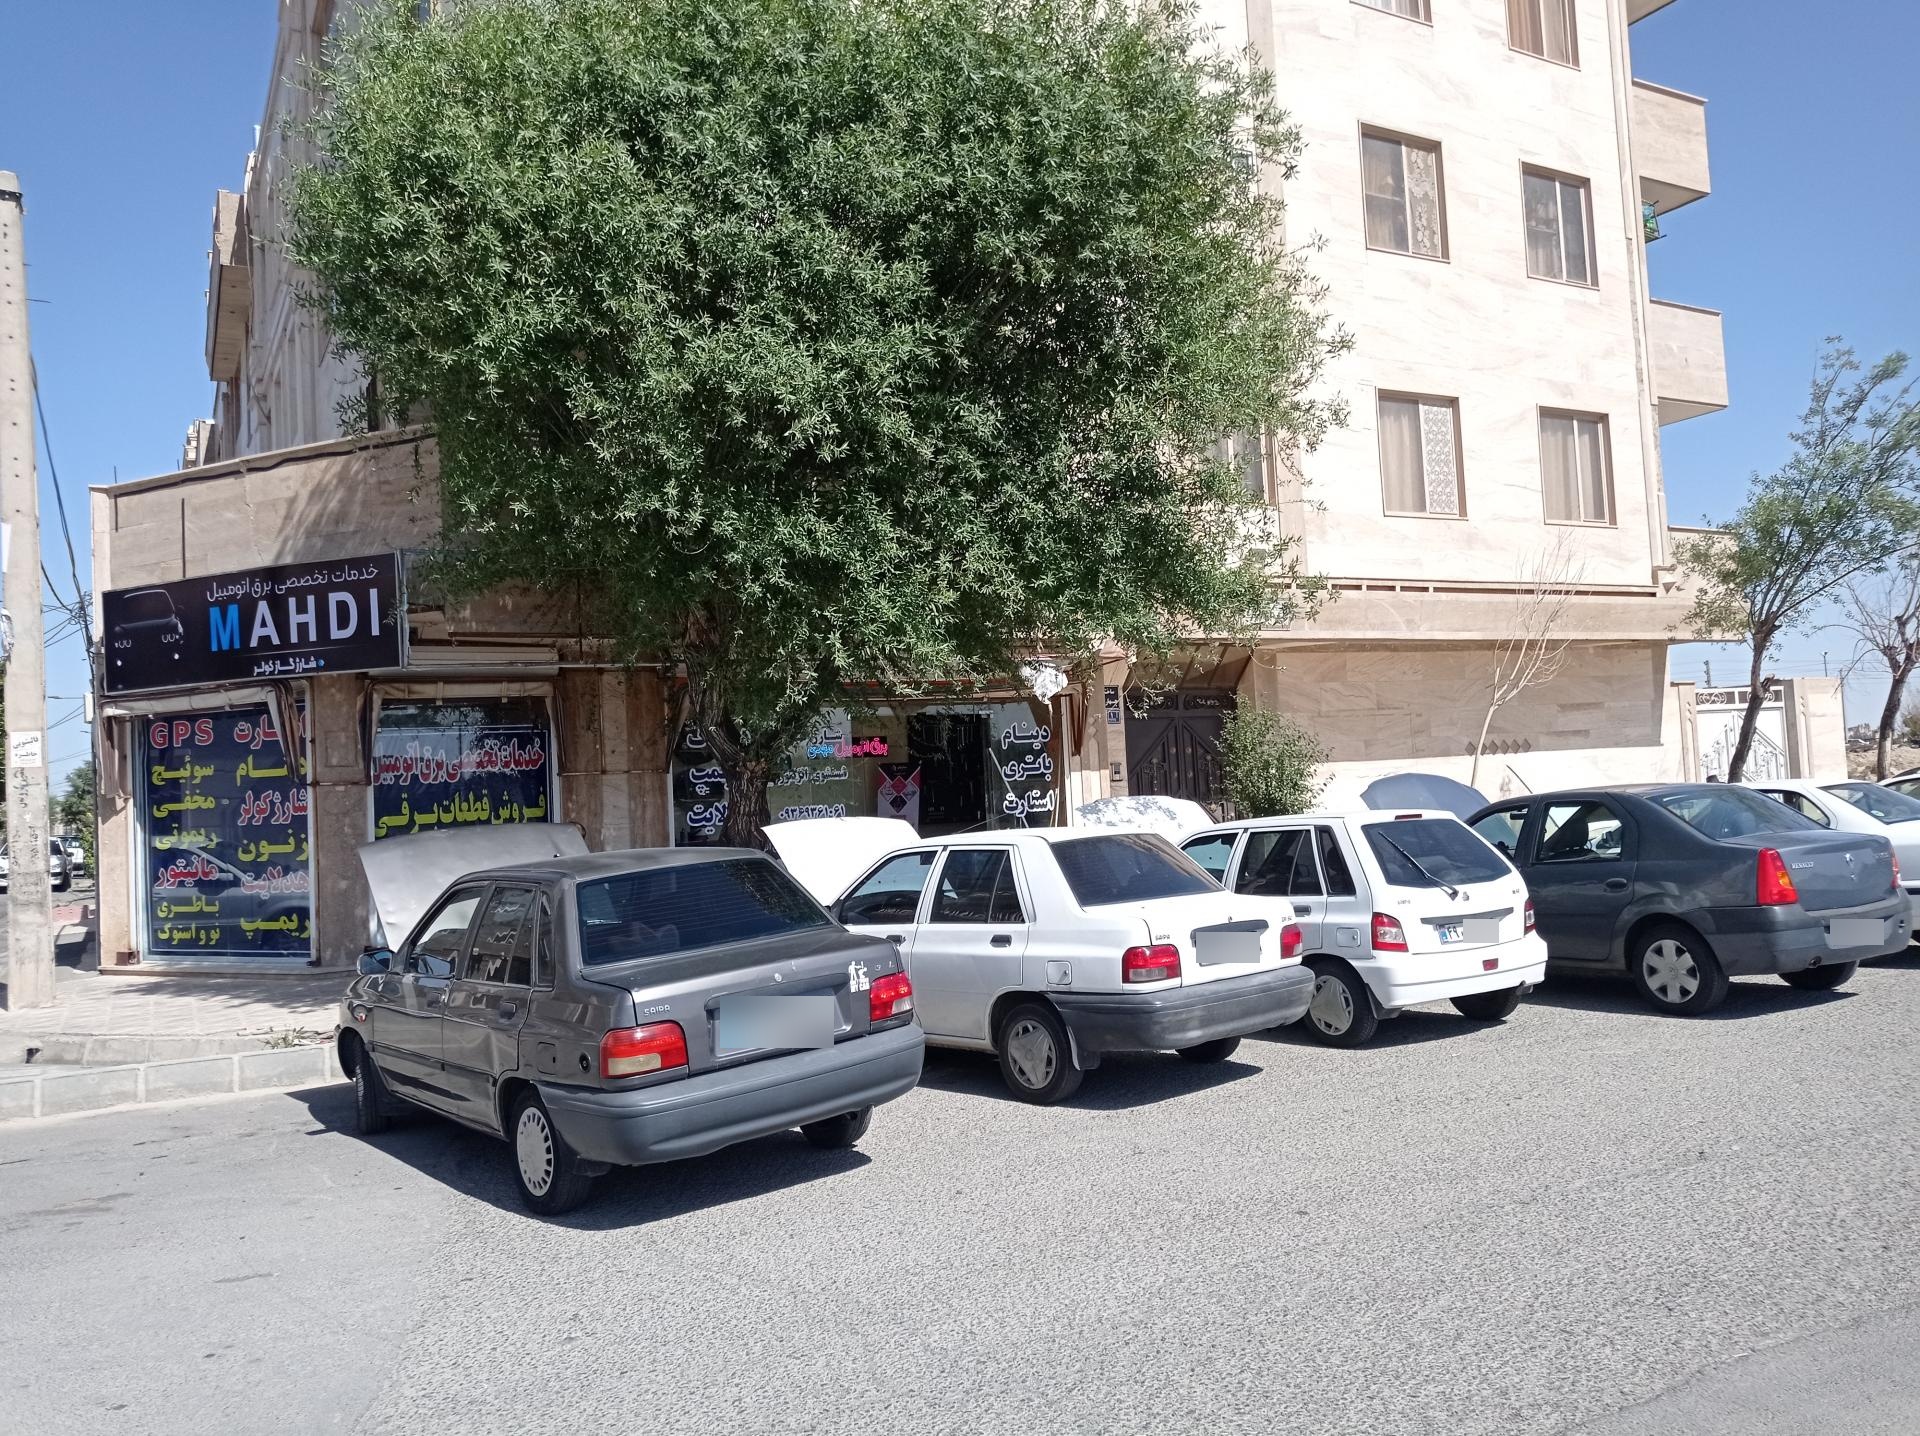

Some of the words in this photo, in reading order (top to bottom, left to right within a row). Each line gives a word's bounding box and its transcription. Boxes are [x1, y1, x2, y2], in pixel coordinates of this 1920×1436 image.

[251, 577, 272, 598] برق
[274, 570, 328, 595] تخصصی
[332, 564, 378, 584] خدمات
[206, 577, 250, 602] اتومبیل
[208, 588, 381, 652] MAHDI
[150, 719, 214, 748] GPS
[1002, 722, 1050, 750] دینام
[502, 738, 544, 770] خدمات
[1002, 753, 1053, 781] باتری
[152, 791, 216, 818] مخفی
[238, 790, 272, 826] کولر
[375, 792, 438, 838] برقی
[438, 788, 490, 824] قطعات
[492, 785, 546, 825] فروش
[1003, 789, 1055, 817] استارت
[154, 824, 218, 850] ریموتی
[237, 829, 308, 862] زنون
[154, 856, 218, 888] مانیتور
[157, 894, 220, 918] باطری
[198, 930, 207, 945] و
[240, 912, 310, 940] ریمپ
